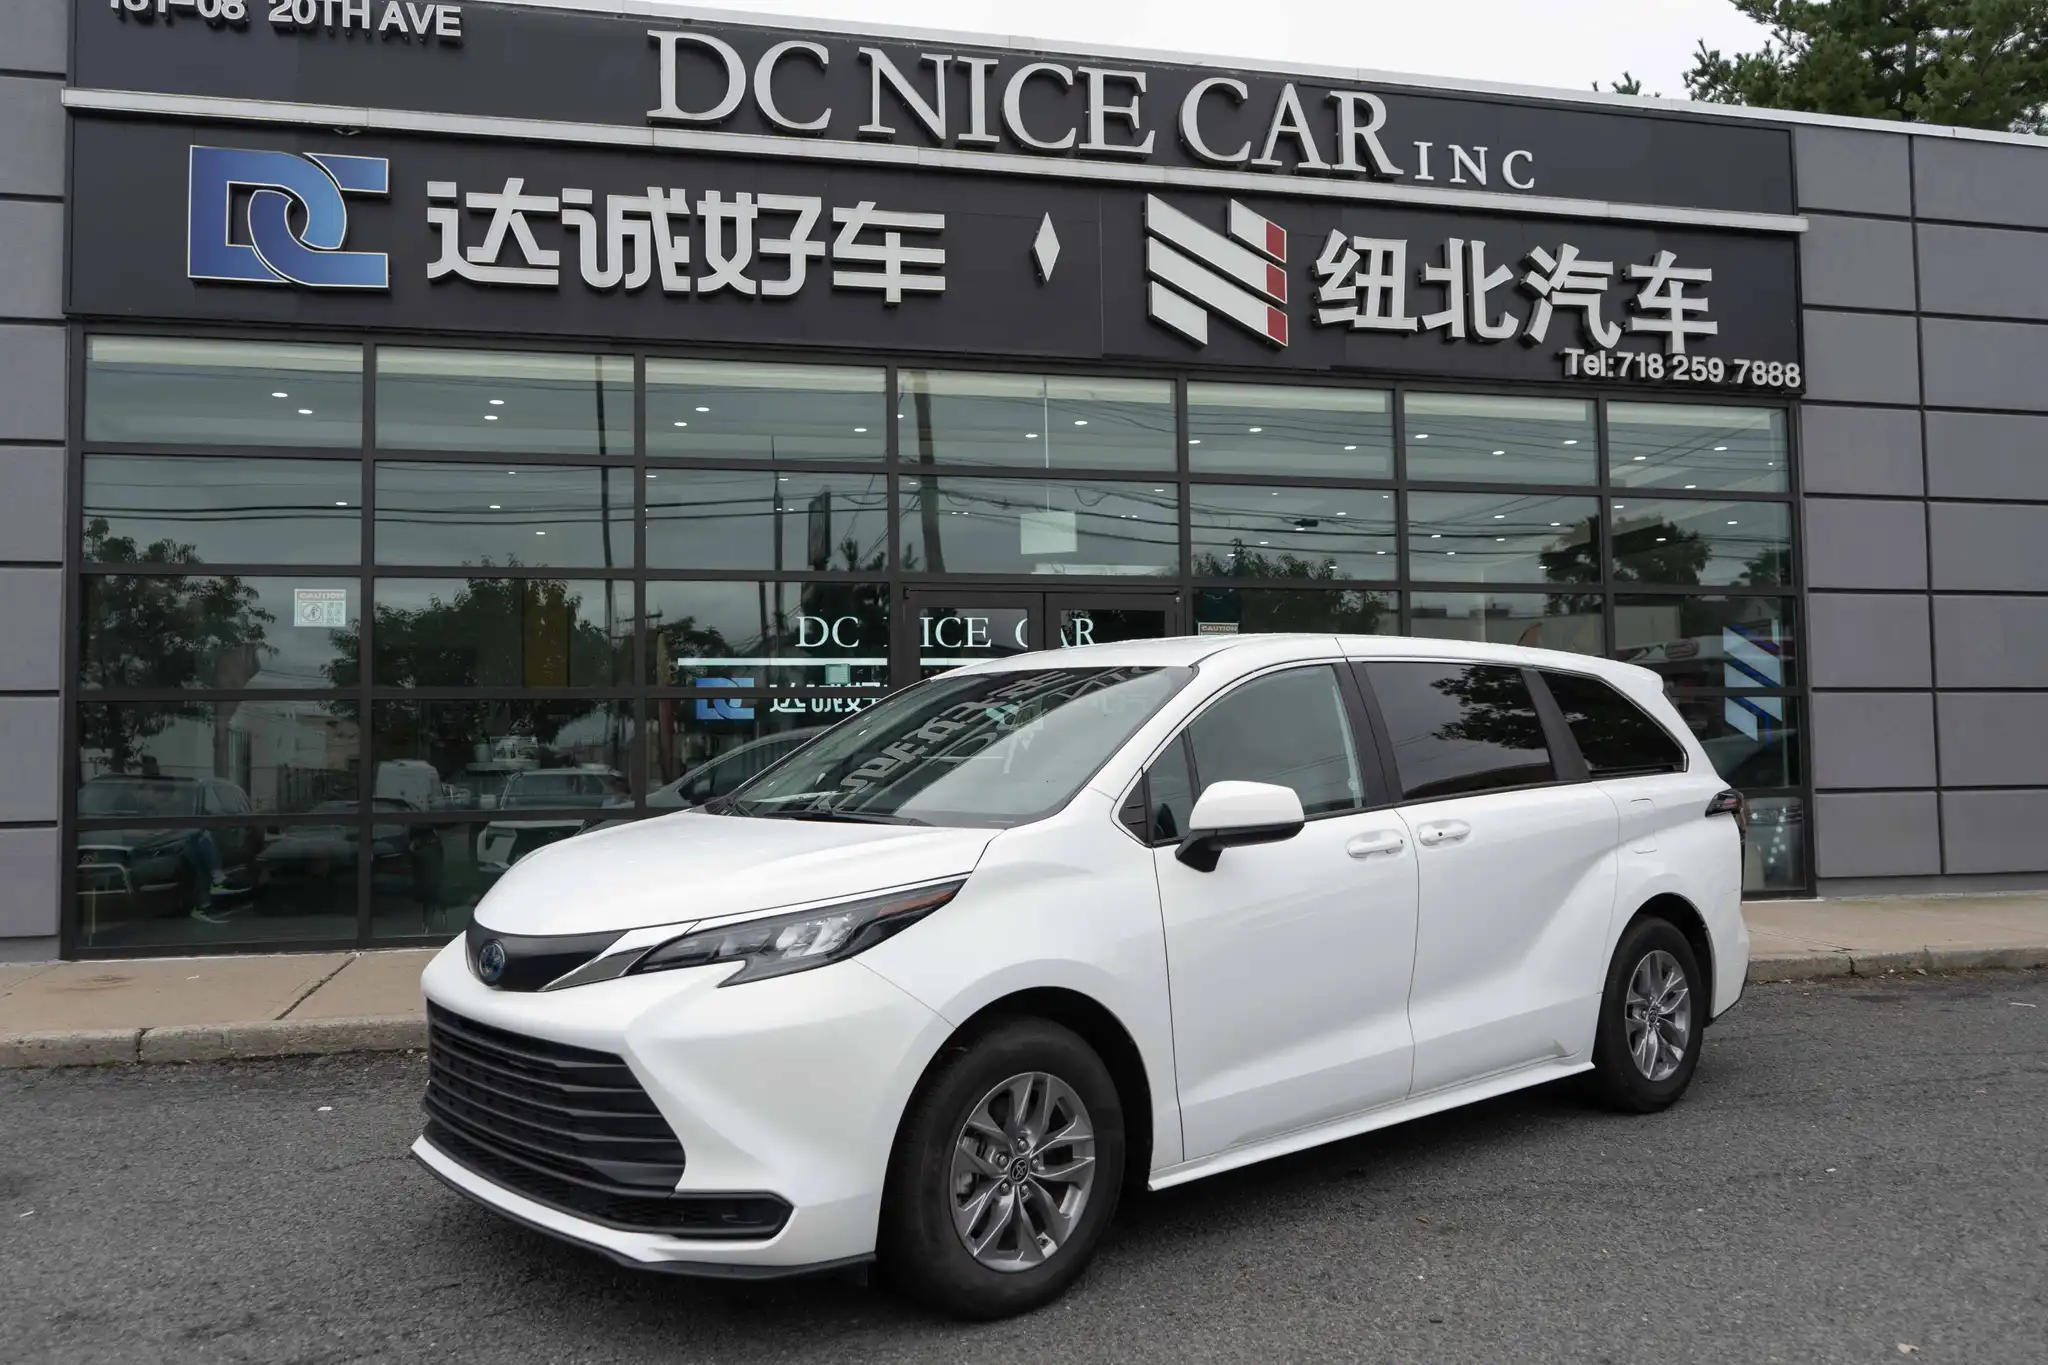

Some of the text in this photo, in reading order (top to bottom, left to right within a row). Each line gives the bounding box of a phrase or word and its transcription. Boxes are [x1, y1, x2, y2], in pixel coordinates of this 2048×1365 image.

[268, 0, 371, 29] 20TH
[378, 0, 463, 37] AVE
[646, 29, 1536, 190] DC NICE CAR INC
[426, 177, 946, 303] 达诚好车
[1314, 228, 1719, 354] 纽北汽车
[1672, 354, 1725, 383] 259
[1733, 358, 1801, 388] 7888
[795, 616, 860, 648] DC
[882, 616, 992, 648] ICE
